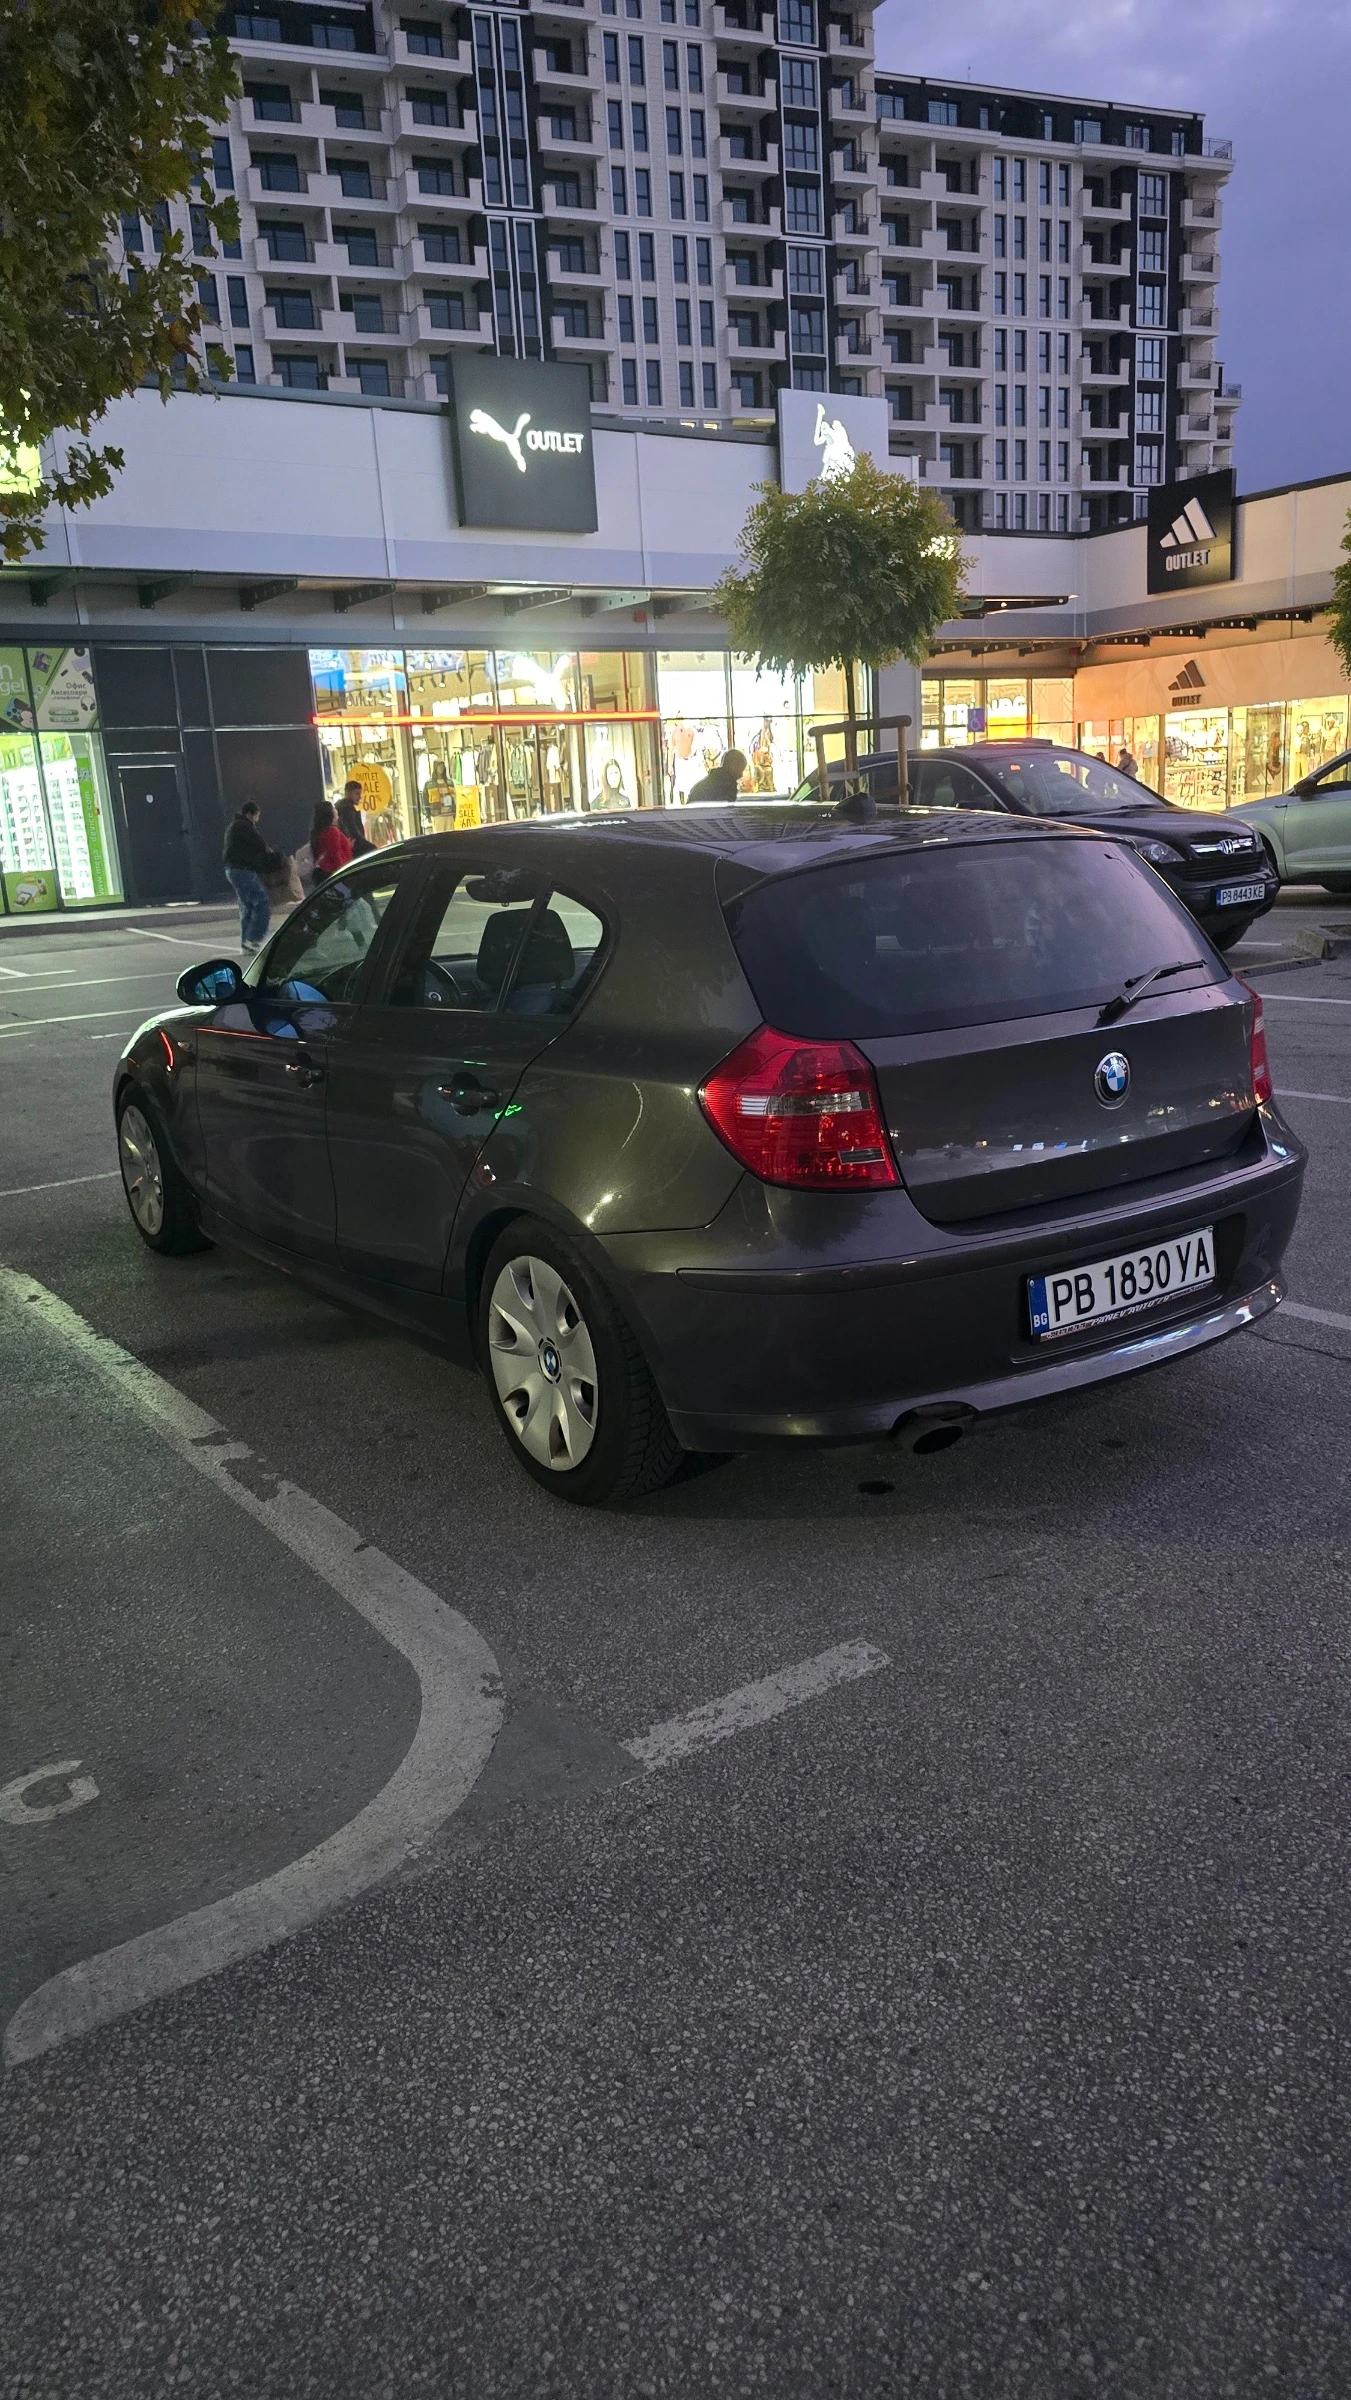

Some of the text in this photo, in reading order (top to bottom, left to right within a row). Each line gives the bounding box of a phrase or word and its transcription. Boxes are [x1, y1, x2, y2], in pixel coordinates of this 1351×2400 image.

[526, 429, 584, 453] OUTLET
[1165, 548, 1210, 572] OUTLET
[1171, 694, 1202, 707] OUTLET
[355, 772, 379, 781] OUTLET
[363, 781, 381, 793] ALE
[458, 809, 475, 818] SALE
[1222, 885, 1264, 904] PB 8443 KE
[1052, 1236, 1211, 1323] PB 1830 YA
[1033, 1312, 1048, 1328] BG
